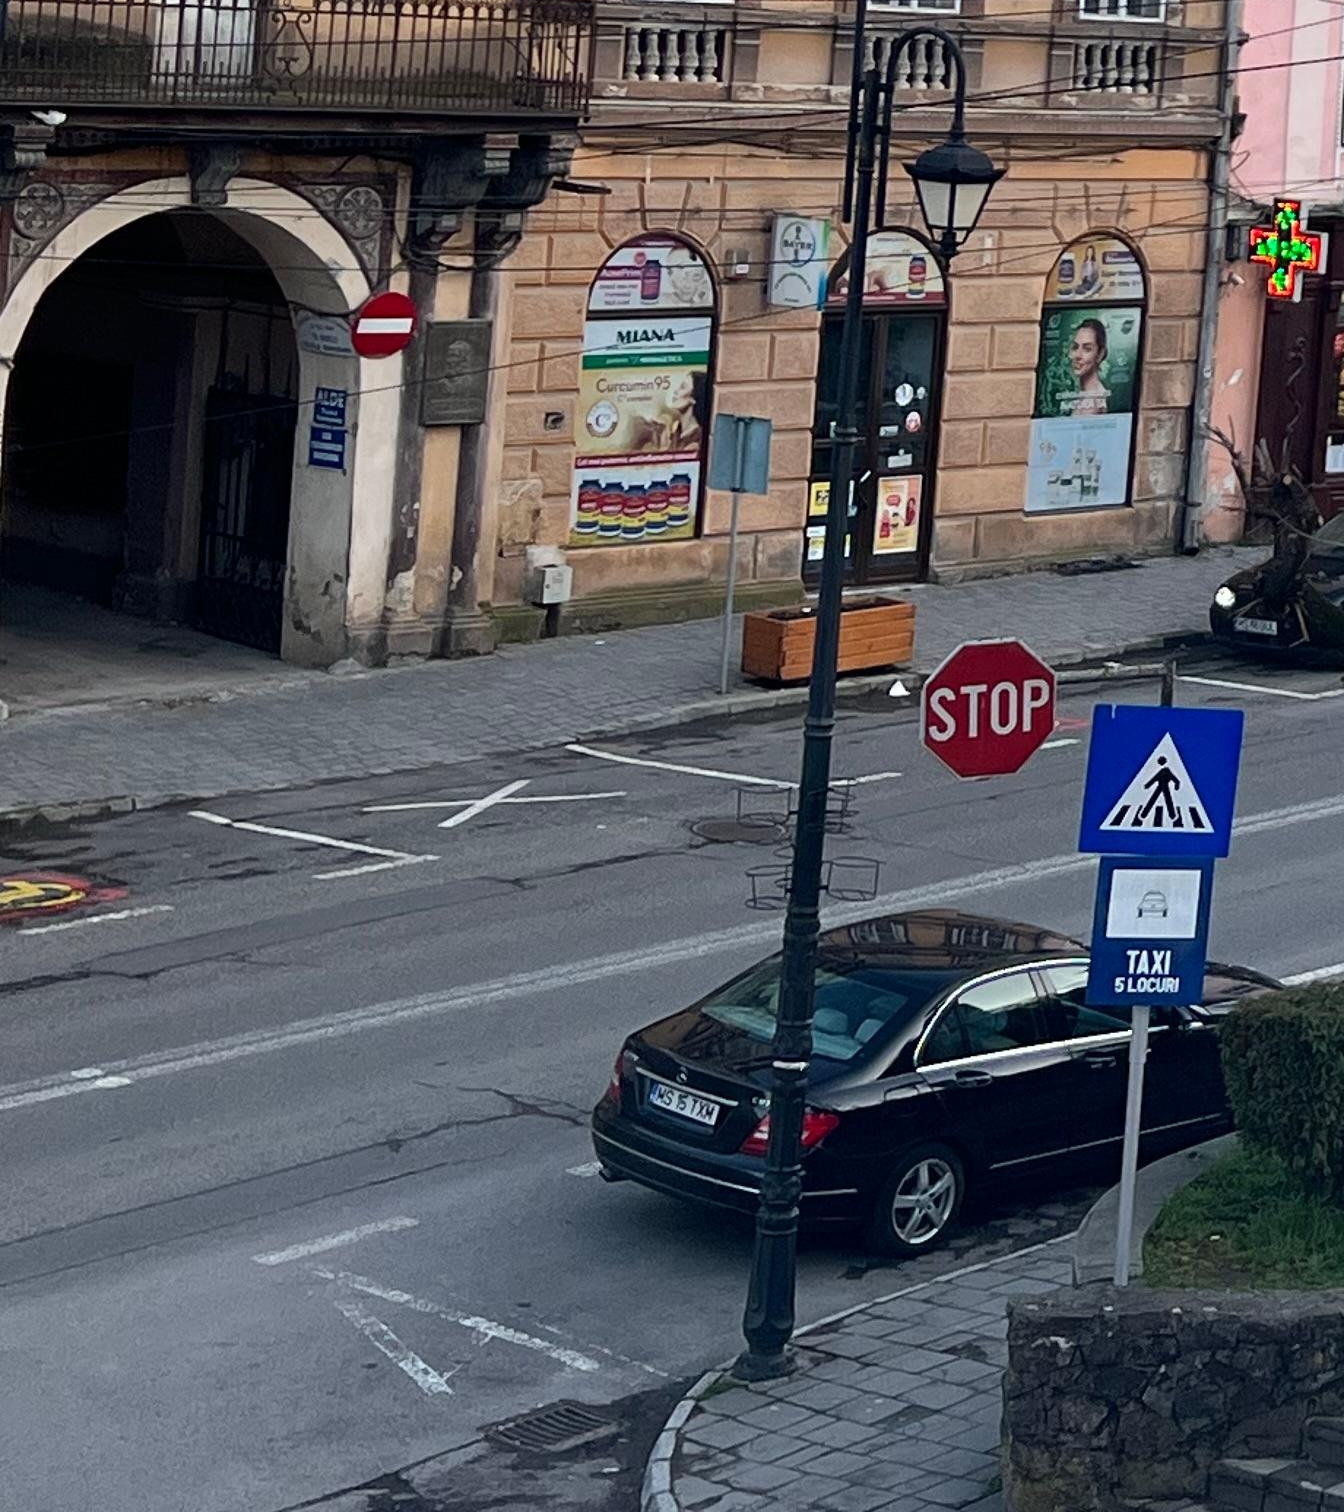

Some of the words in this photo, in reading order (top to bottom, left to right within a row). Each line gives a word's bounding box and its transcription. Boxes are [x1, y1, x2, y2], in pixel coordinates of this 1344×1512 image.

[616, 328, 675, 344] MIANA
[928, 678, 1050, 742] STOP
[1126, 950, 1172, 975] TAXI
[1114, 977, 1126, 993] 5
[1126, 977, 1180, 993] LOCURI
